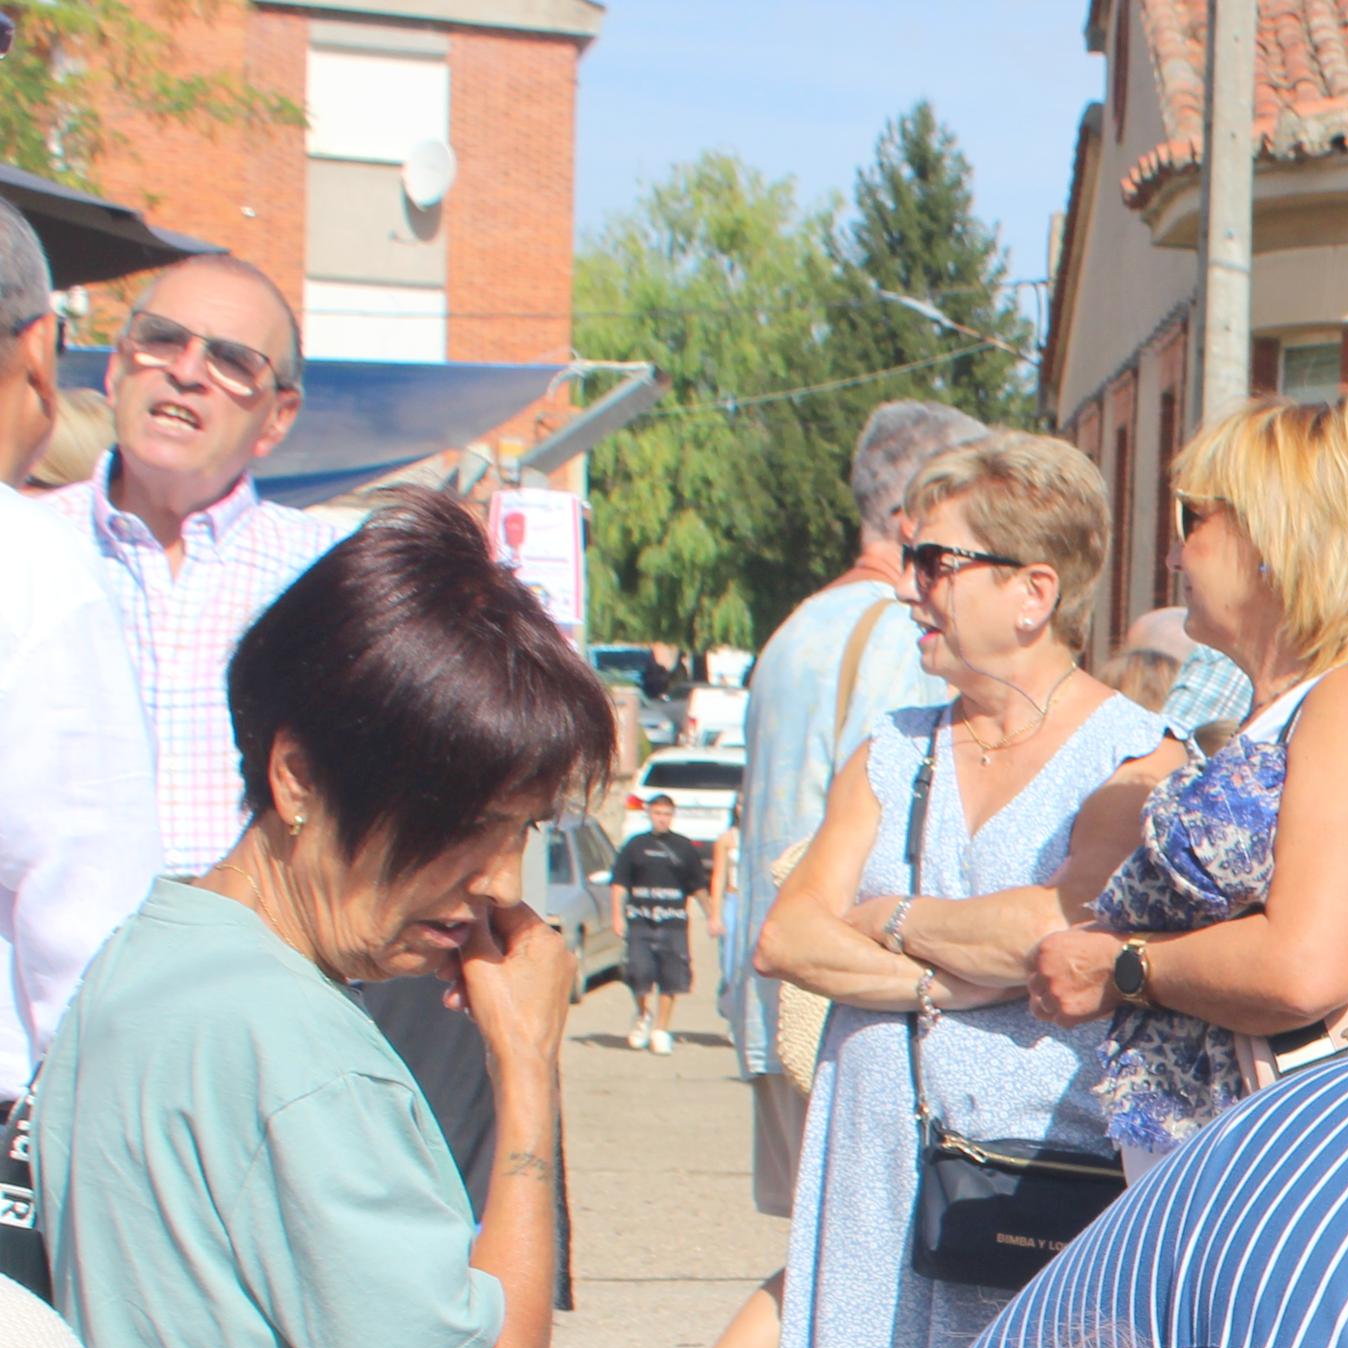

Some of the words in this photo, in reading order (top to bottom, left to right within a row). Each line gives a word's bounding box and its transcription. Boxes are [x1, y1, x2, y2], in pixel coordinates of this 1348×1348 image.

[996, 1232, 1035, 1248] BIMBA
[1038, 1239, 1046, 1249] Y
[1048, 1241, 1067, 1252] LO
